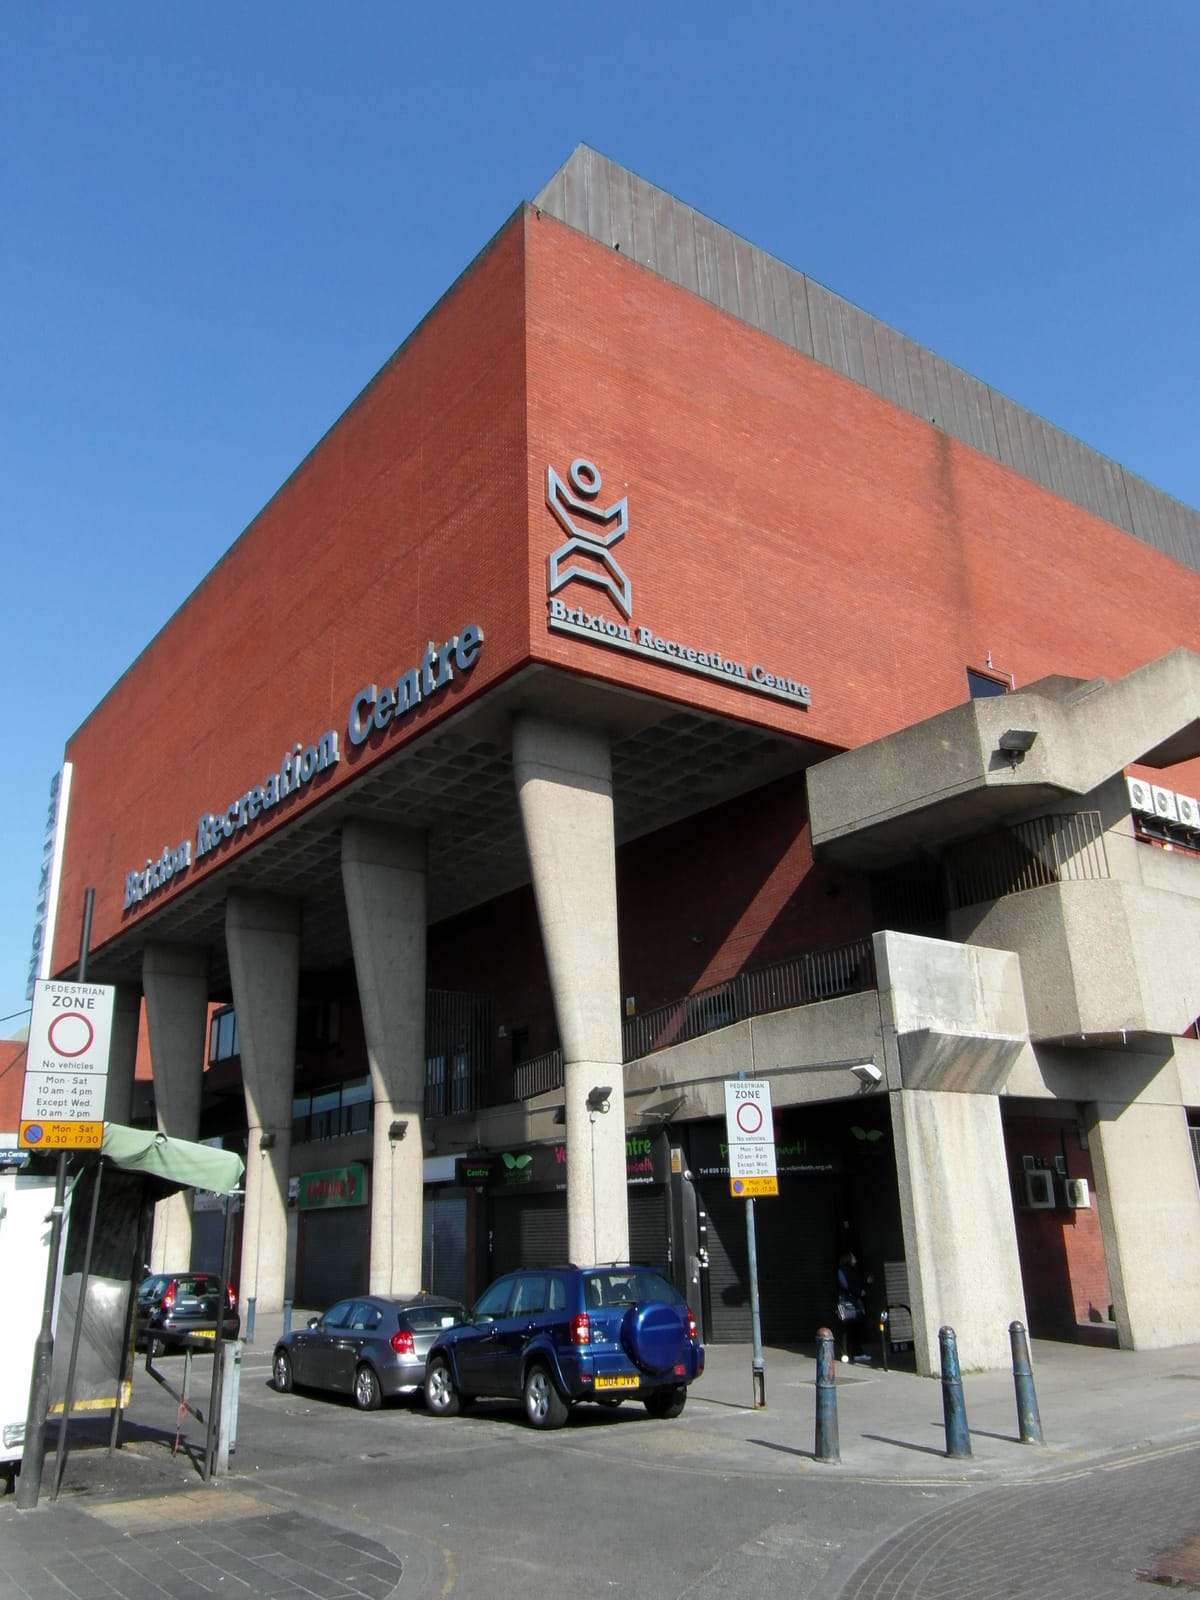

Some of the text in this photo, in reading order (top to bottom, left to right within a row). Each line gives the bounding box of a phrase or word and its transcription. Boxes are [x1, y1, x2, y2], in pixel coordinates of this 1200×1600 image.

[550, 597, 810, 697] Brixton Recreation Centre
[123, 623, 485, 910] Brixton Recreation Centre
[44, 984, 105, 996] PEDESTRIAN
[52, 996, 95, 1009] ZONE
[42, 1060, 94, 1070] No vehicles
[736, 1090, 760, 1099] ZONE
[36, 1098, 68, 1107] Except
[626, 1137, 652, 1156] ntre
